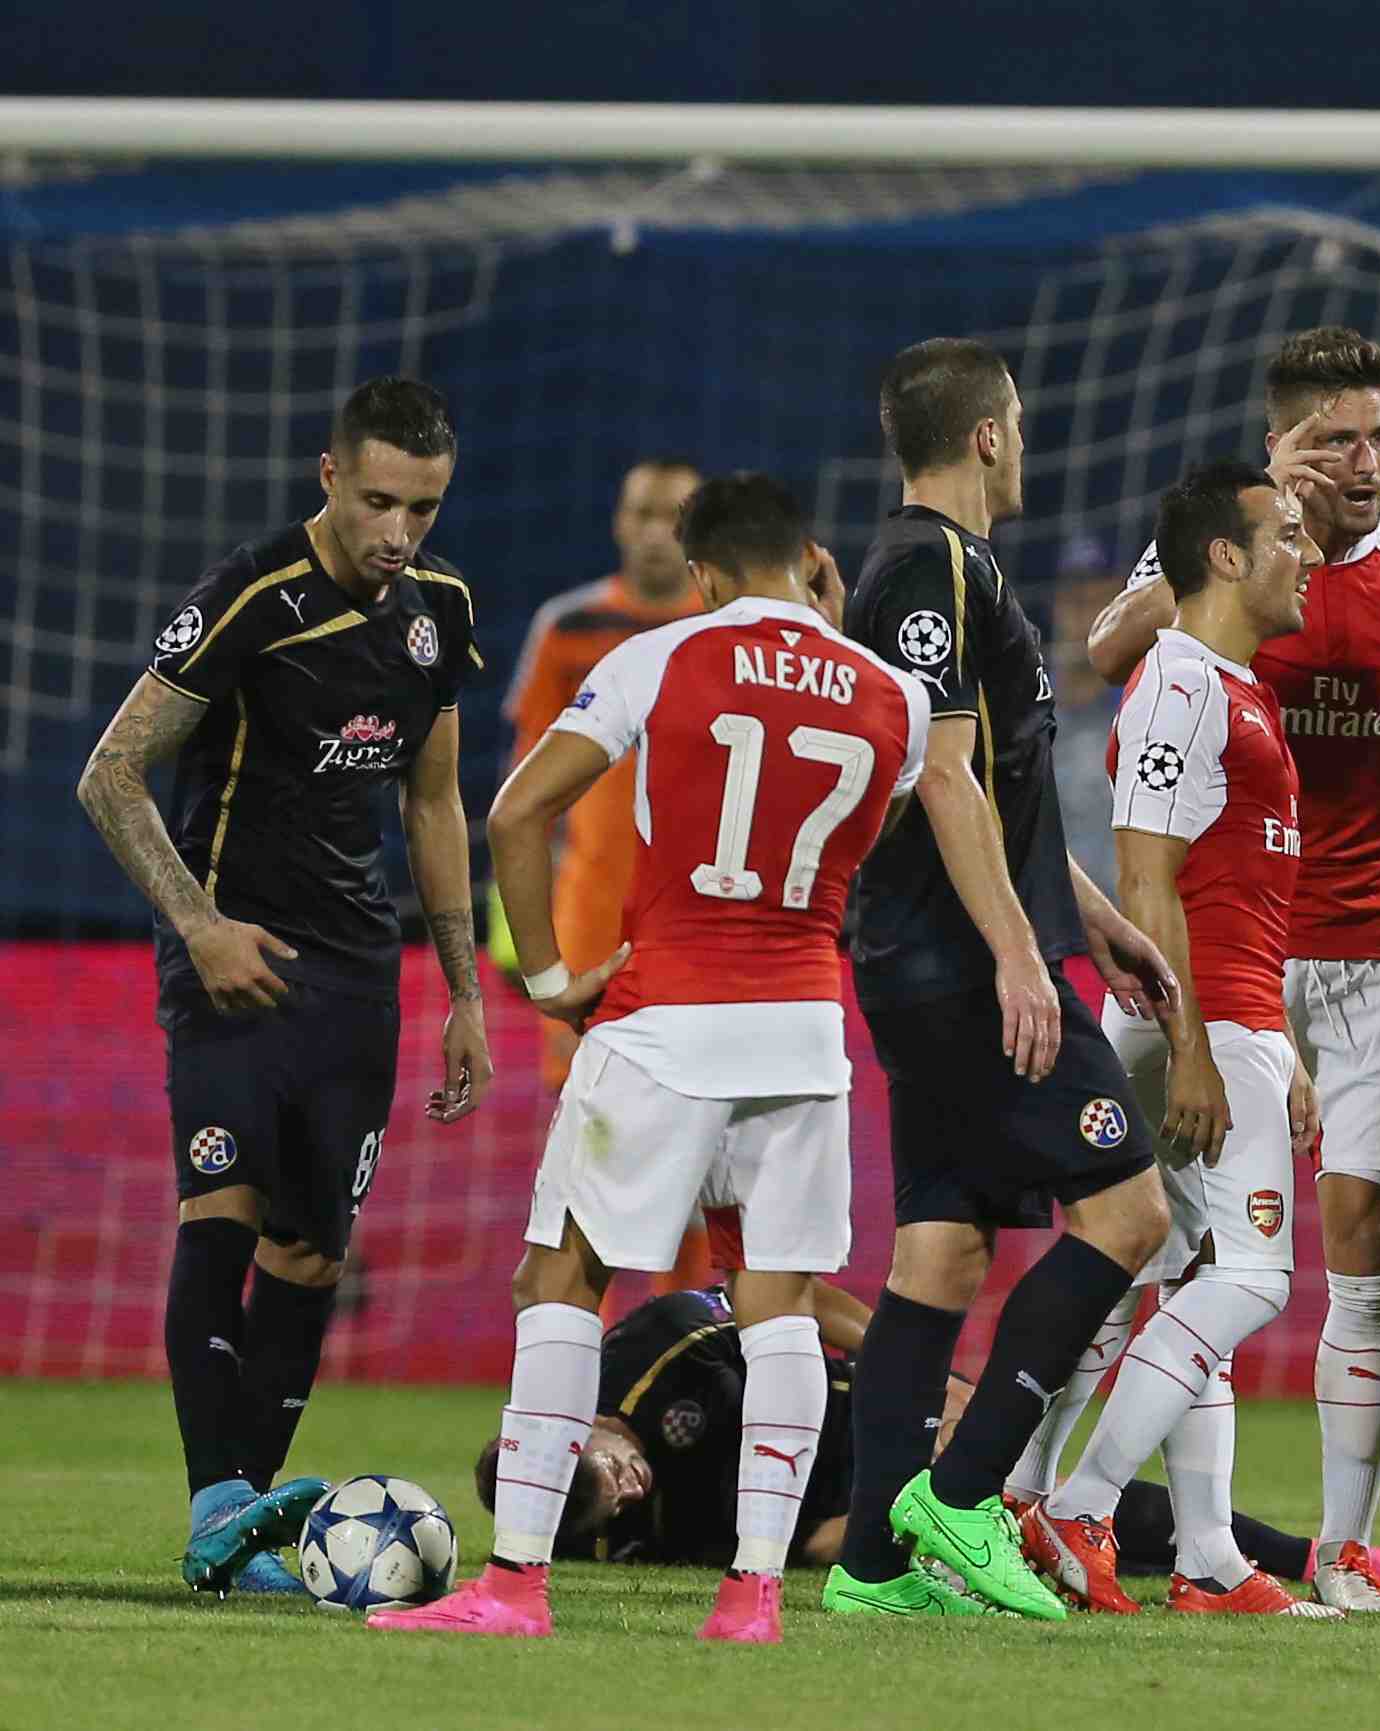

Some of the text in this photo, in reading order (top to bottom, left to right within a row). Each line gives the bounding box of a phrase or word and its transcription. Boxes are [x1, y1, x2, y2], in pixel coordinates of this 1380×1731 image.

[734, 645, 856, 704] ALEXIS
[1313, 676, 1359, 706] Fly
[690, 713, 875, 910] 17
